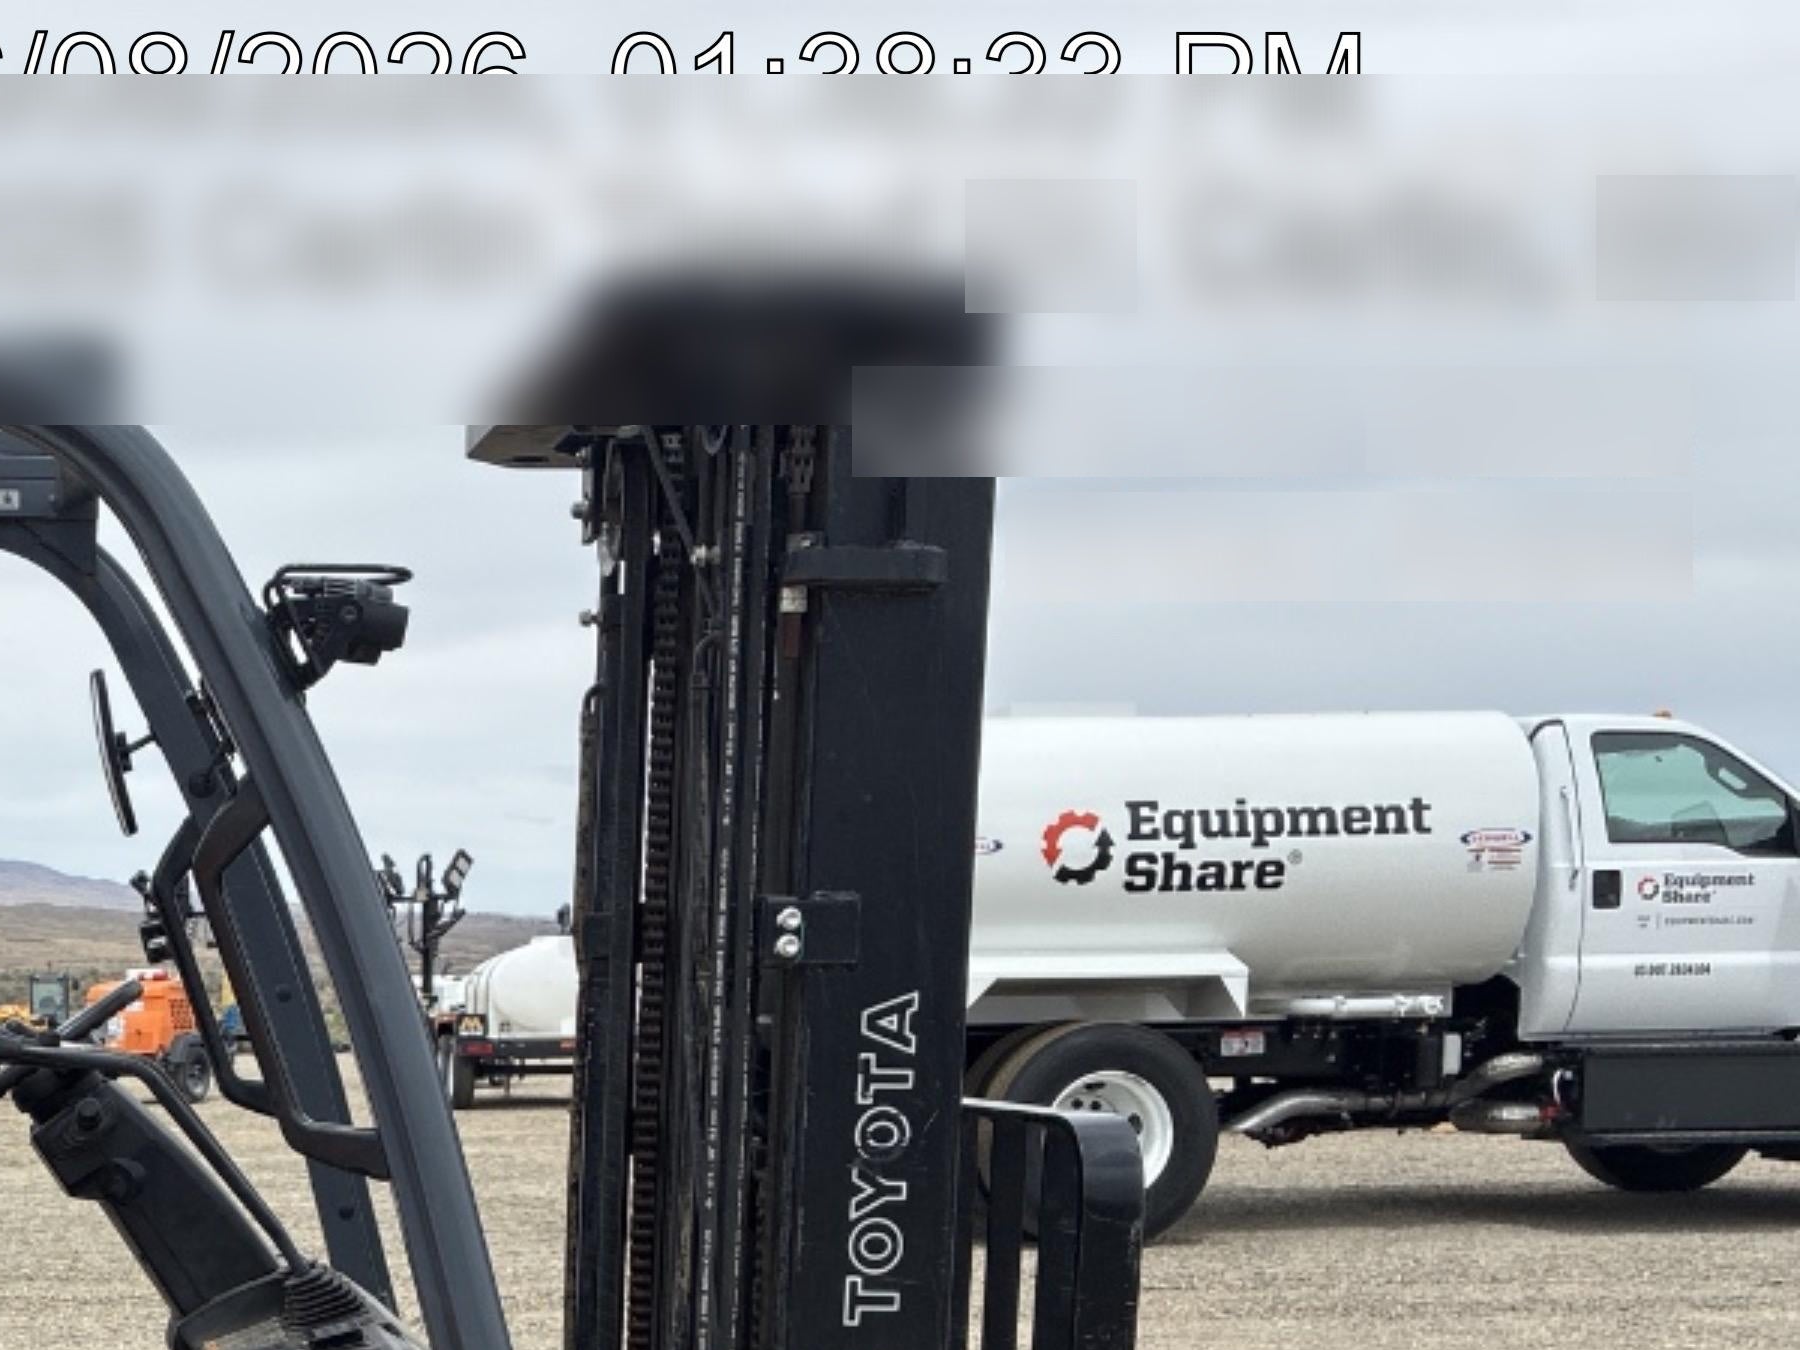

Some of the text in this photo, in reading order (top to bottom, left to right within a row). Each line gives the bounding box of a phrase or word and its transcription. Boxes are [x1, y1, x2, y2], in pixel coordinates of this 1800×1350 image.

[1125, 797, 1432, 850] Equipment
[1663, 873, 1756, 888] Equipment
[842, 991, 920, 1327] TOYOTA
